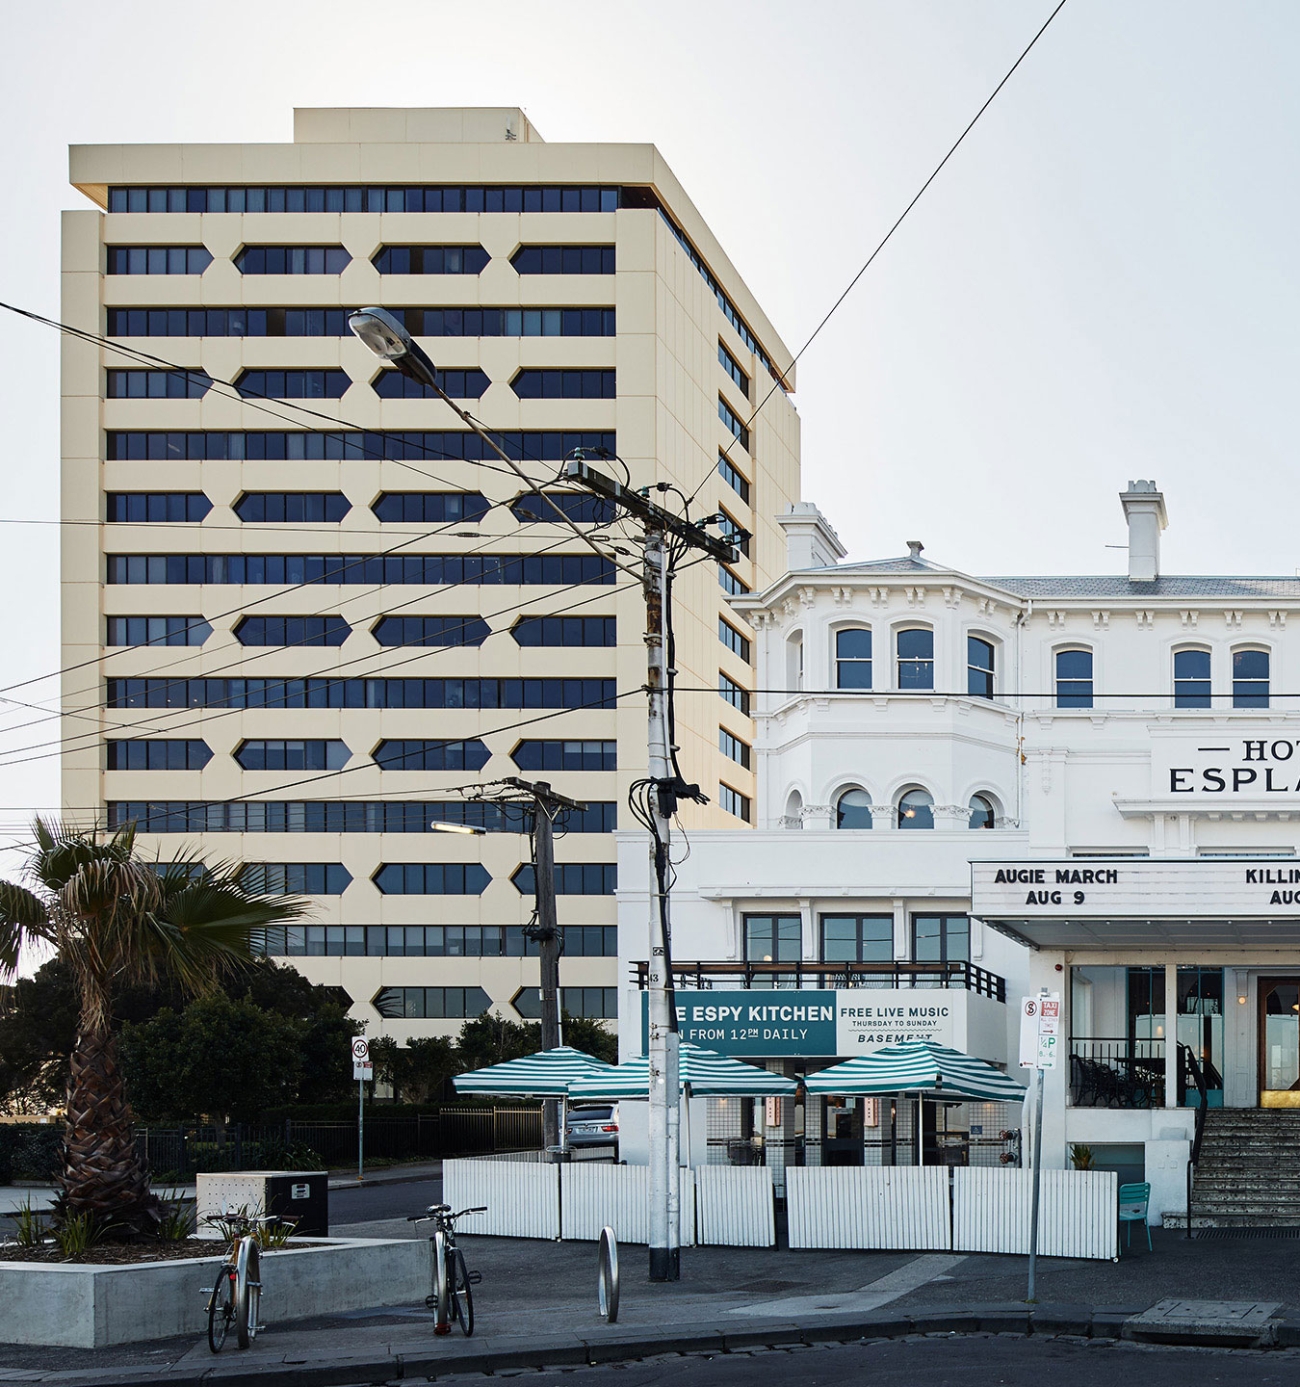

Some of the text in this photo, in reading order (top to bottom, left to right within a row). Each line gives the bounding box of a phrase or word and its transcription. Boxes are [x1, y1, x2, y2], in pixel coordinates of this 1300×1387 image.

[995, 869, 1118, 884] AUGIE MARCH
[1025, 891, 1085, 905] AUG 9
[692, 1006, 743, 1022] ESPY
[748, 1006, 833, 1022] KITCHEN
[840, 1007, 949, 1018] FREE LIVE MUSIC
[689, 1028, 725, 1040] FROM
[764, 1028, 808, 1040] DAILY
[355, 1044, 366, 1053] 40
